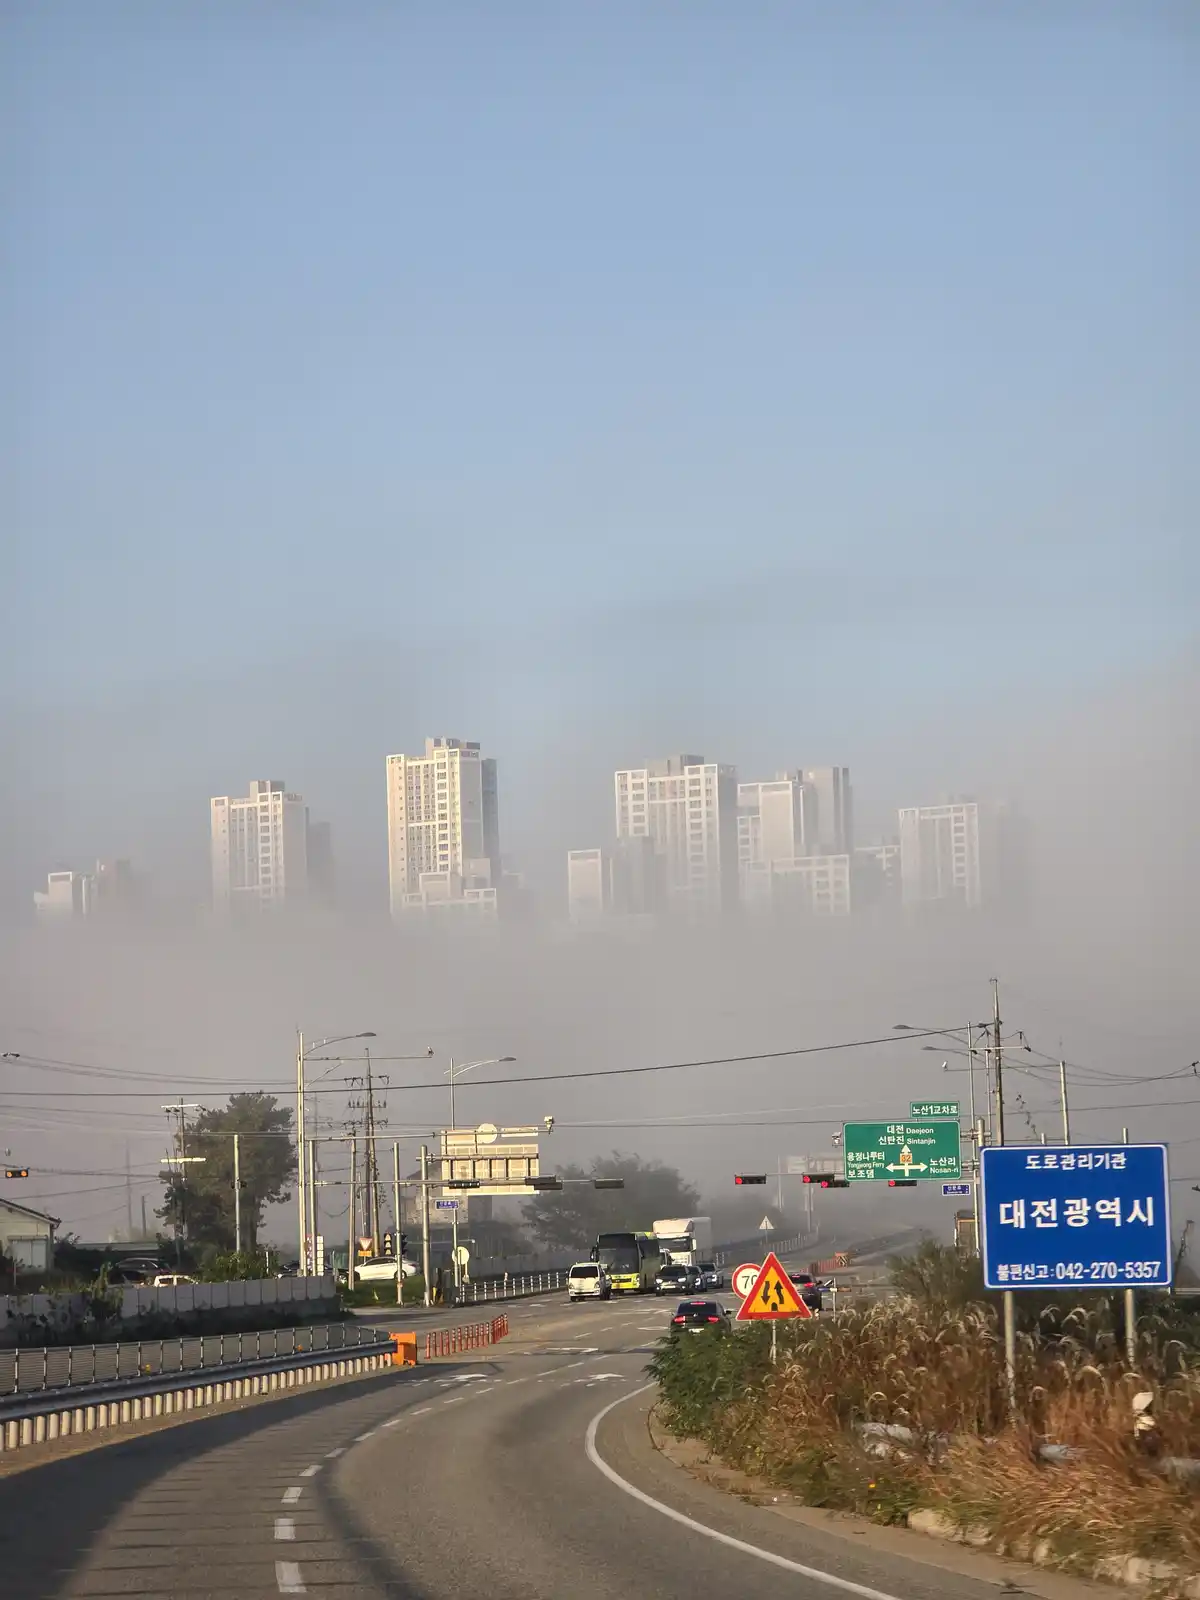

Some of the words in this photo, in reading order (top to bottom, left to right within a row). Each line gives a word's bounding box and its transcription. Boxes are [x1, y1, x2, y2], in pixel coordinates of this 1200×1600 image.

[912, 1105, 958, 1115] 노산1교차로
[887, 1125, 904, 1135] 대전
[906, 1128, 934, 1136] Daejeon
[878, 1135, 905, 1145] 신탄진
[906, 1138, 936, 1146] Sintanjin
[901, 1154, 911, 1163] 32
[930, 1156, 956, 1166] 노산리
[1025, 1152, 1127, 1170] 도로관리기관
[848, 1169, 875, 1178] 보조댐
[999, 1196, 1155, 1229] 대전광역시
